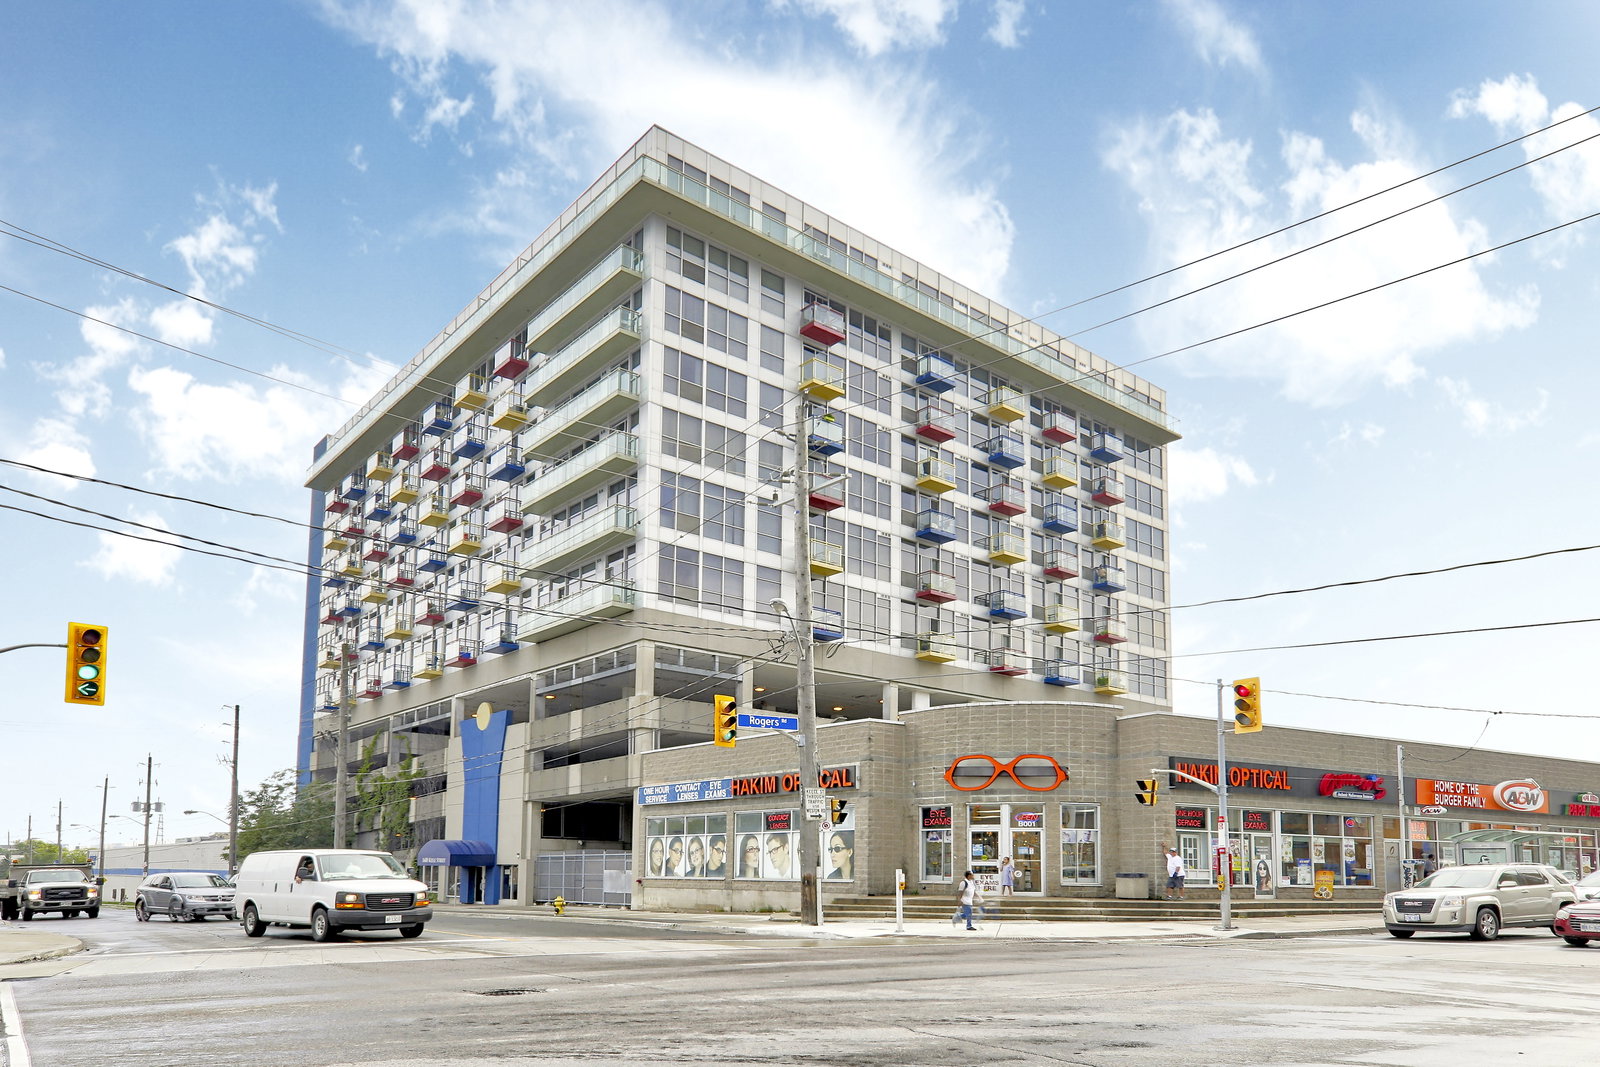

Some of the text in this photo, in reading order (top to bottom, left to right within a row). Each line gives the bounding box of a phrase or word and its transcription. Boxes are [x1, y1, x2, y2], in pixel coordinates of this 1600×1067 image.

[749, 716, 780, 728] Rogers
[731, 776, 776, 796] HAKIM
[782, 768, 853, 792] OPCAL
[1230, 766, 1292, 790] OPTICAL
[674, 782, 702, 793] CONTACT
[709, 780, 722, 790] EYE
[1434, 780, 1480, 795] HOME OF THE
[643, 785, 670, 796] ONE HOUR
[704, 789, 727, 799] EXAMS
[645, 794, 668, 803] SERVICE
[677, 791, 699, 801] LENSES
[1434, 793, 1487, 808] BURGER FAMILY
[1506, 790, 1540, 806] A&W
[930, 809, 946, 818] EYE
[1248, 812, 1262, 821] EYE
[924, 817, 952, 826] EXAMS
[1177, 819, 1201, 827] SERVICE
[1243, 821, 1268, 830] EXAMS
